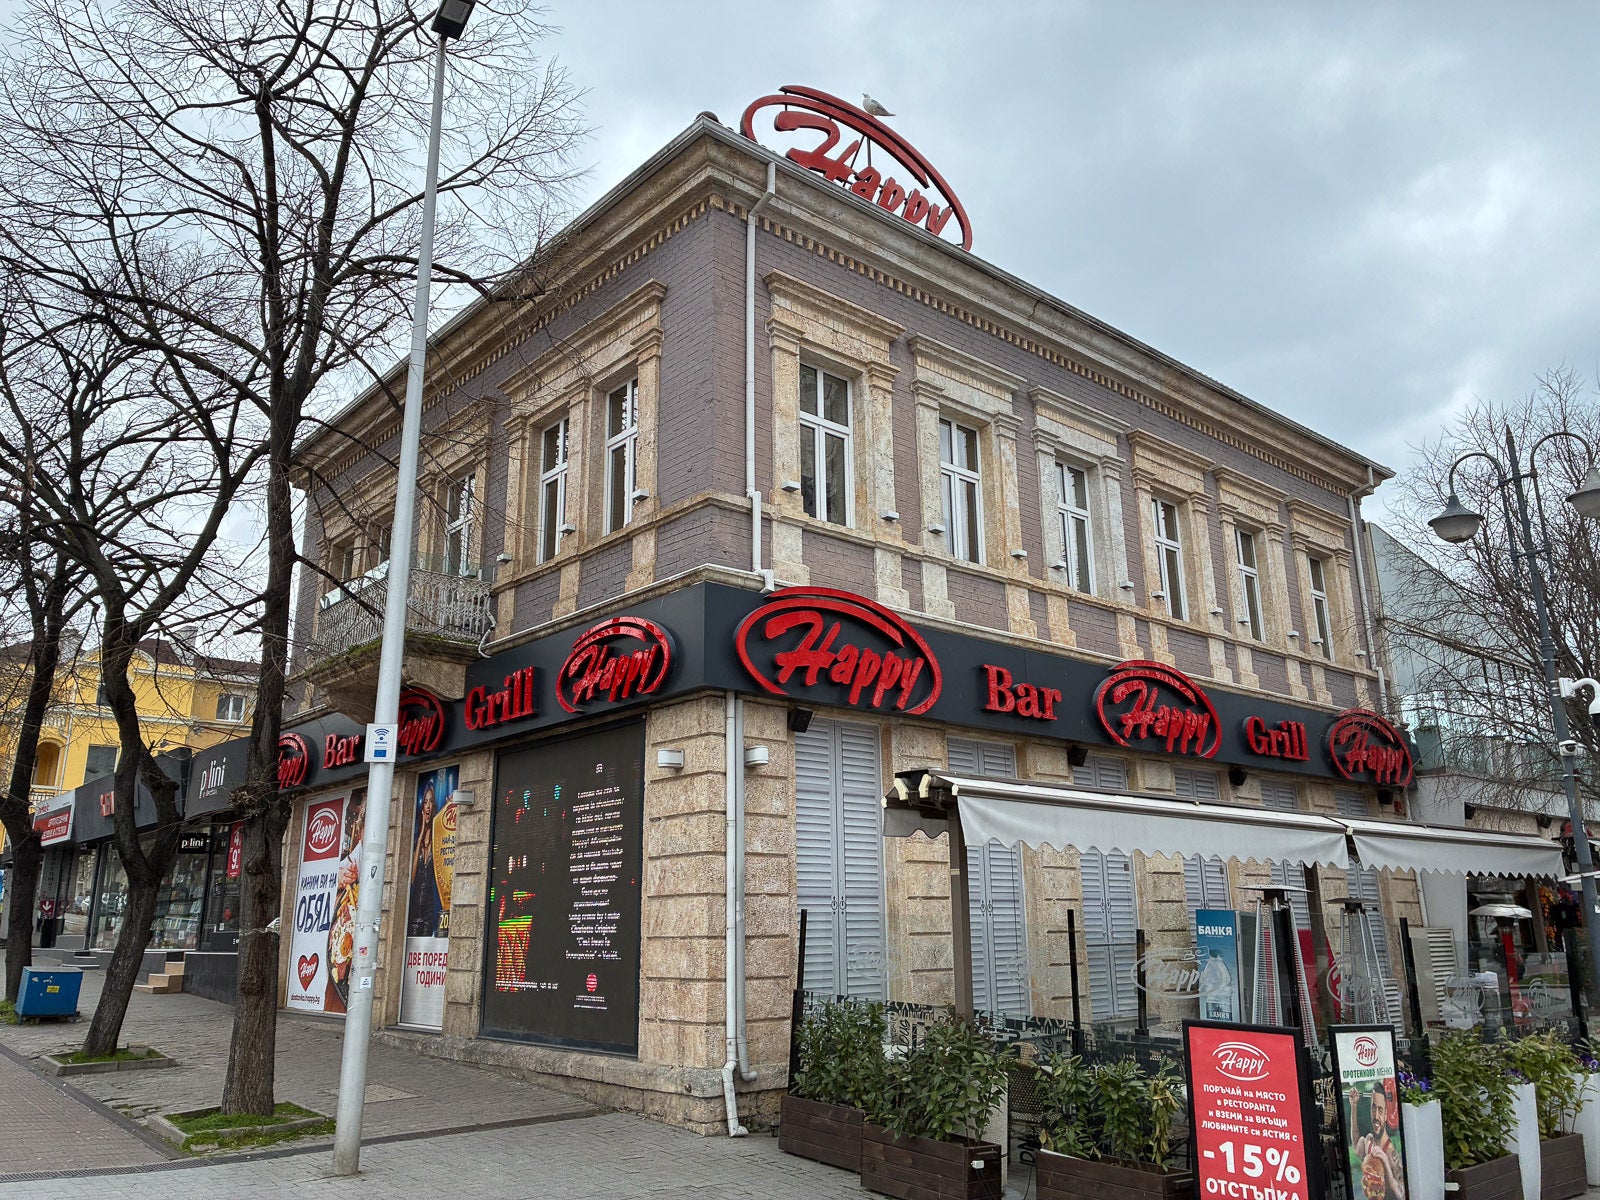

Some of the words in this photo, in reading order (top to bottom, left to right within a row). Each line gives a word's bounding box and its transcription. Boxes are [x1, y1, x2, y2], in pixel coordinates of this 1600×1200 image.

[774, 110, 953, 236] Happy
[568, 642, 660, 702] Happy
[765, 610, 924, 710] Happy
[464, 667, 534, 731] Grill
[983, 663, 1062, 721] Bar
[1114, 679, 1210, 754] Happy
[323, 733, 360, 769] Bar
[1246, 715, 1310, 761] Grill
[1339, 724, 1404, 784] Happy
[278, 752, 303, 789] appy
[312, 820, 336, 844] Happy
[301, 875, 319, 890] КАНИМ
[320, 874, 329, 889] ВИ
[329, 873, 337, 887] НА
[297, 892, 330, 933] ОБЯД
[1198, 925, 1233, 936] БАНКЯ
[407, 952, 421, 968] ДВЕ
[423, 952, 448, 969] ПОРЕД
[1217, 1050, 1265, 1074] Happy
[1356, 1044, 1377, 1060] Happy
[1203, 1084, 1242, 1096] ПОРЪЧАЙ
[1244, 1090, 1254, 1098] на
[1256, 1090, 1286, 1101] МЯСТО
[1224, 1099, 1276, 1113] РЕСТОРАНТА
[1201, 1120, 1249, 1134] ЛЮБИМИТЕ
[1250, 1128, 1260, 1136] си
[1262, 1129, 1290, 1140] ЯСТИЯ
[1215, 1110, 1242, 1121] ВЗЕМИ
[1255, 1116, 1287, 1128] ВКЪЩИ
[1203, 1141, 1301, 1184] -15%
